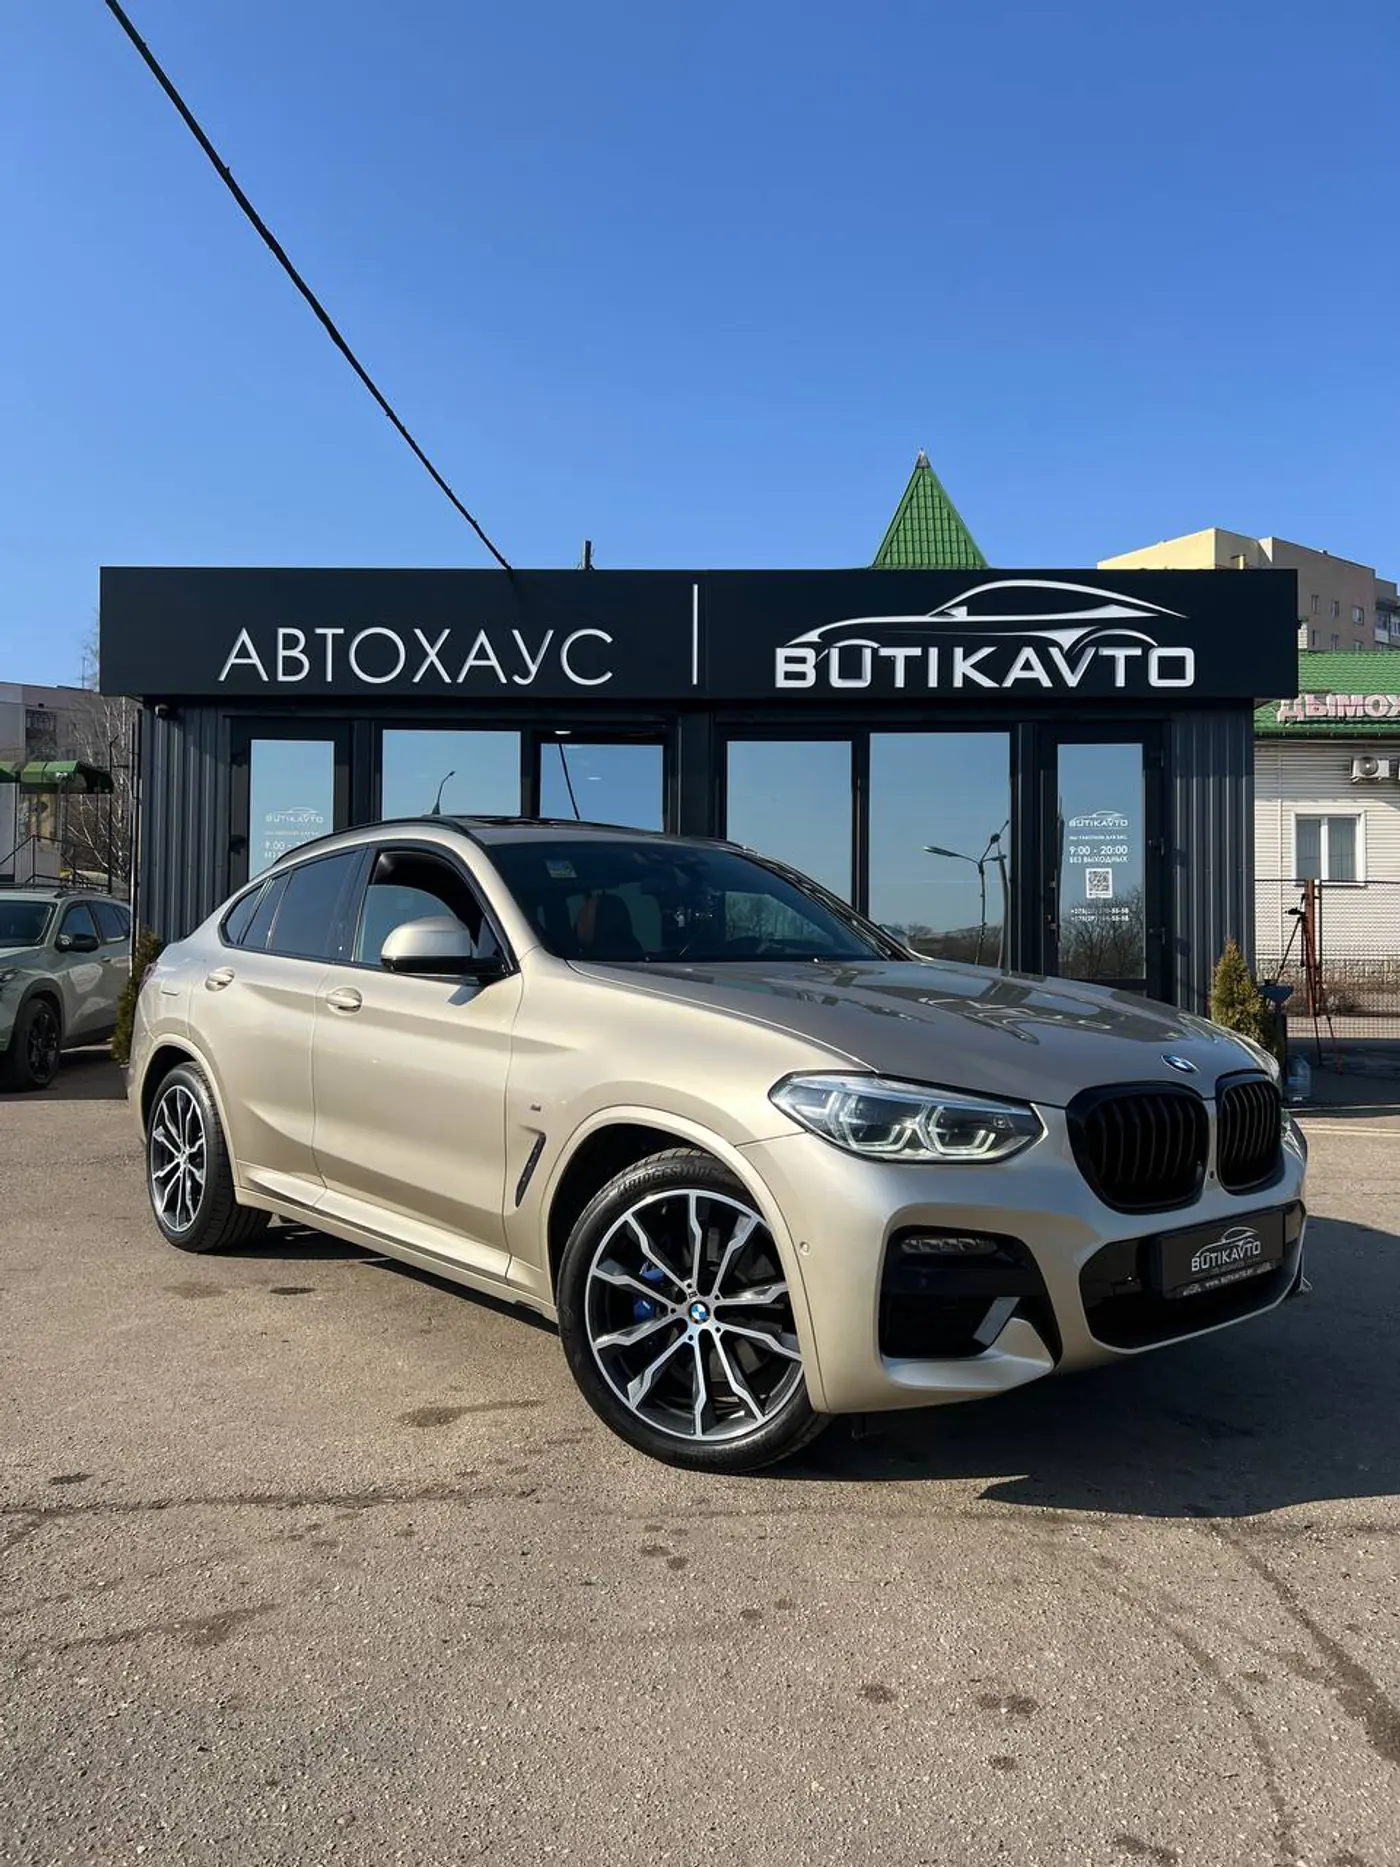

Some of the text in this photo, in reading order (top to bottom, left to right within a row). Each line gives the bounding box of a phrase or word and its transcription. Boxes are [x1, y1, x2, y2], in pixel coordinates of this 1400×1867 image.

[218, 626, 614, 686] АВТОХАУС
[775, 645, 1196, 689] BUTIKAVTO
[1068, 818, 1129, 827] BUTIKAVTO
[1069, 845, 1091, 855] 9:00
[1100, 845, 1128, 855] 20:00
[1191, 1241, 1261, 1272] BUTIKAVTO
